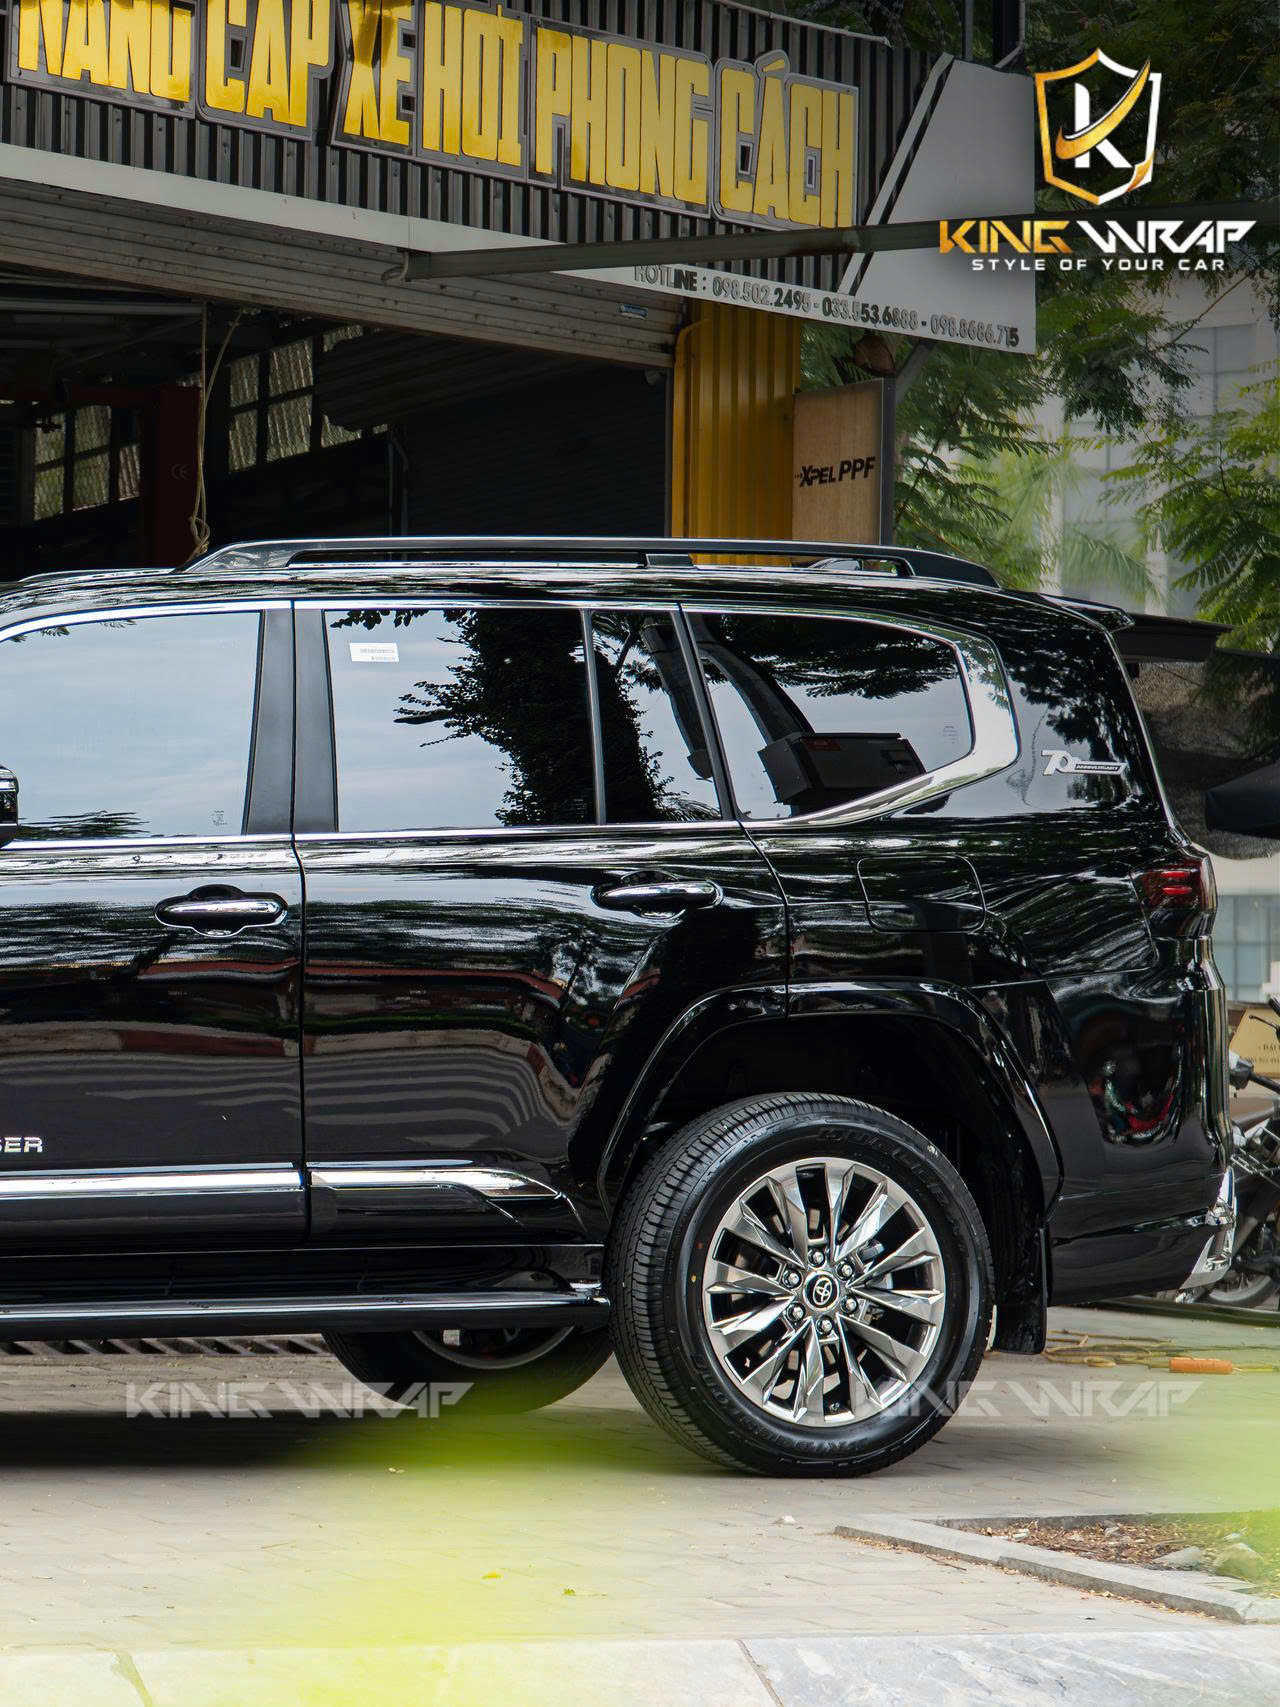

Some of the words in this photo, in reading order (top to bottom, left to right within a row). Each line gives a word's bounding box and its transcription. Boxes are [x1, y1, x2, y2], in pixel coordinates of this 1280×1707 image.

[343, 0, 411, 146] XE
[536, 27, 710, 206] PHONG
[720, 58, 853, 228] CÁCH
[838, 456, 876, 482] PPF
